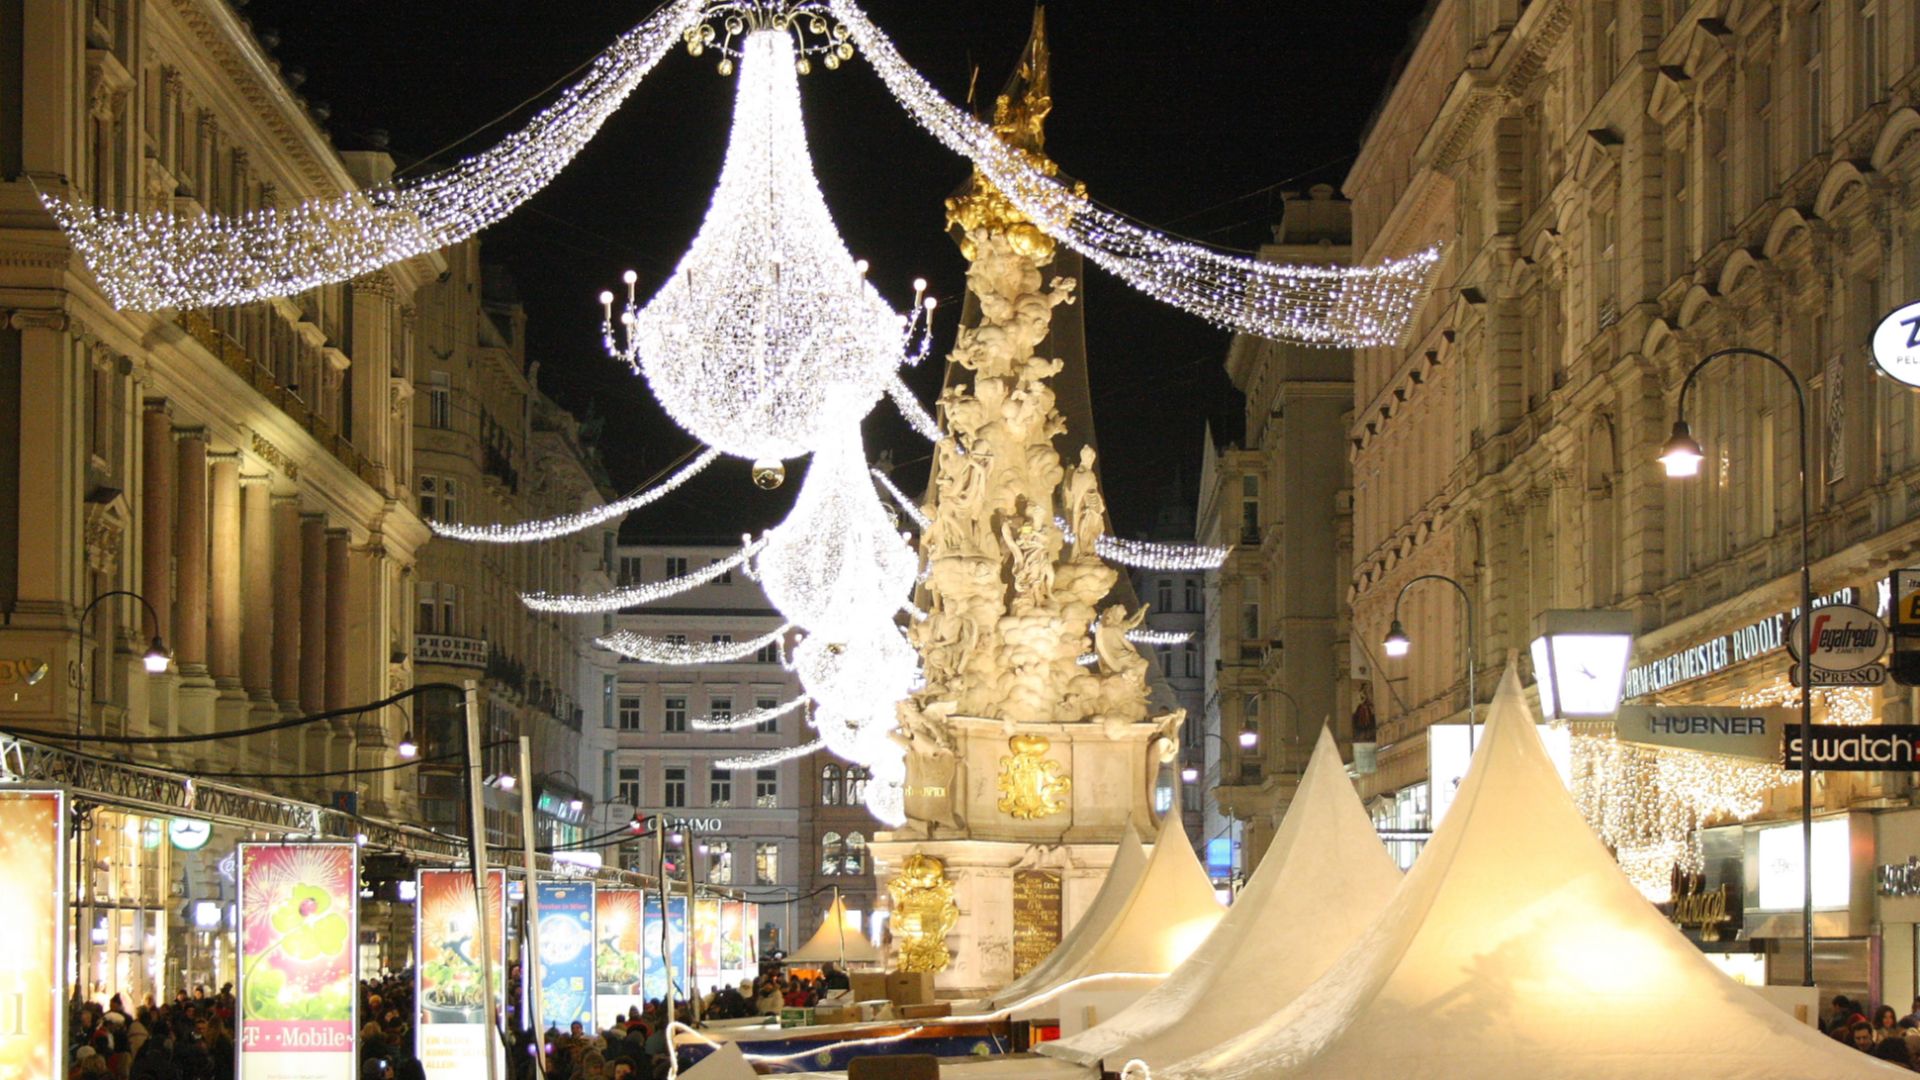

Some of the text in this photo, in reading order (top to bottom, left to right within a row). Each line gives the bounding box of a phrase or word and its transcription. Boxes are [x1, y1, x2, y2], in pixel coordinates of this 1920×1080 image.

[1896, 356, 1920, 365] PEL
[1810, 614, 1879, 655] Segafredo
[417, 637, 484, 653] PHOENIX
[1619, 612, 1784, 700] HRMACHERMEISTER RUDOLF
[1808, 667, 1880, 683] SPRESSO
[1651, 716, 1766, 735] HÜBNER
[1789, 733, 1912, 762] swatch
